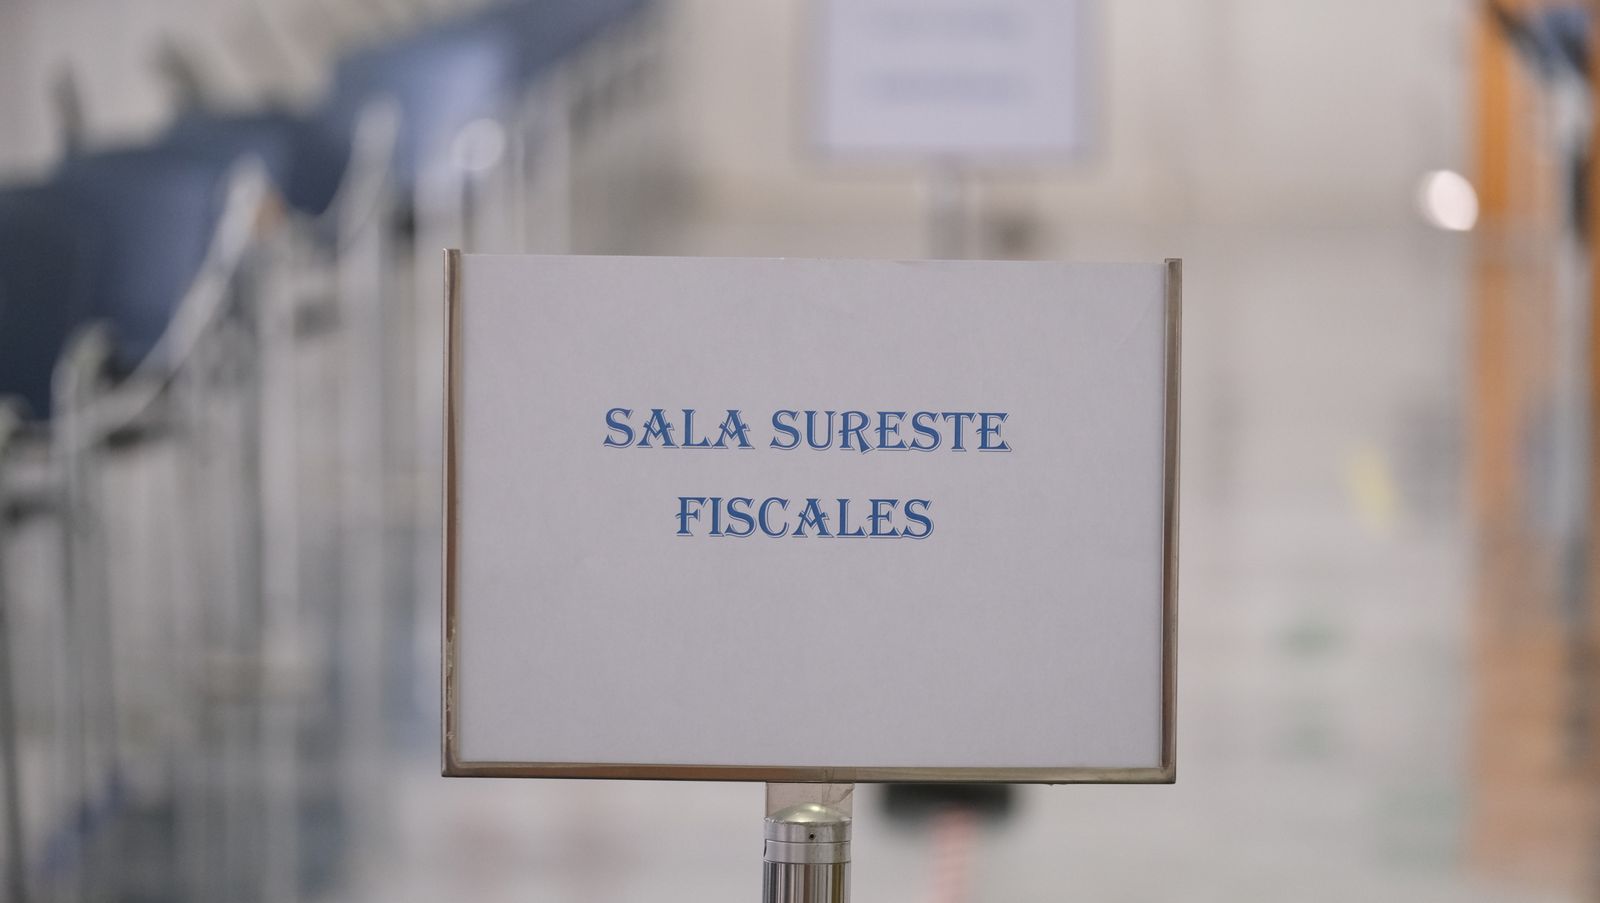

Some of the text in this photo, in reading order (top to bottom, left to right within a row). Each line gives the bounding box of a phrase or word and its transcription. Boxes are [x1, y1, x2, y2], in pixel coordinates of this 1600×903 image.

[603, 408, 1012, 454] SALA SURESTE
[675, 497, 934, 540] FISCALES
